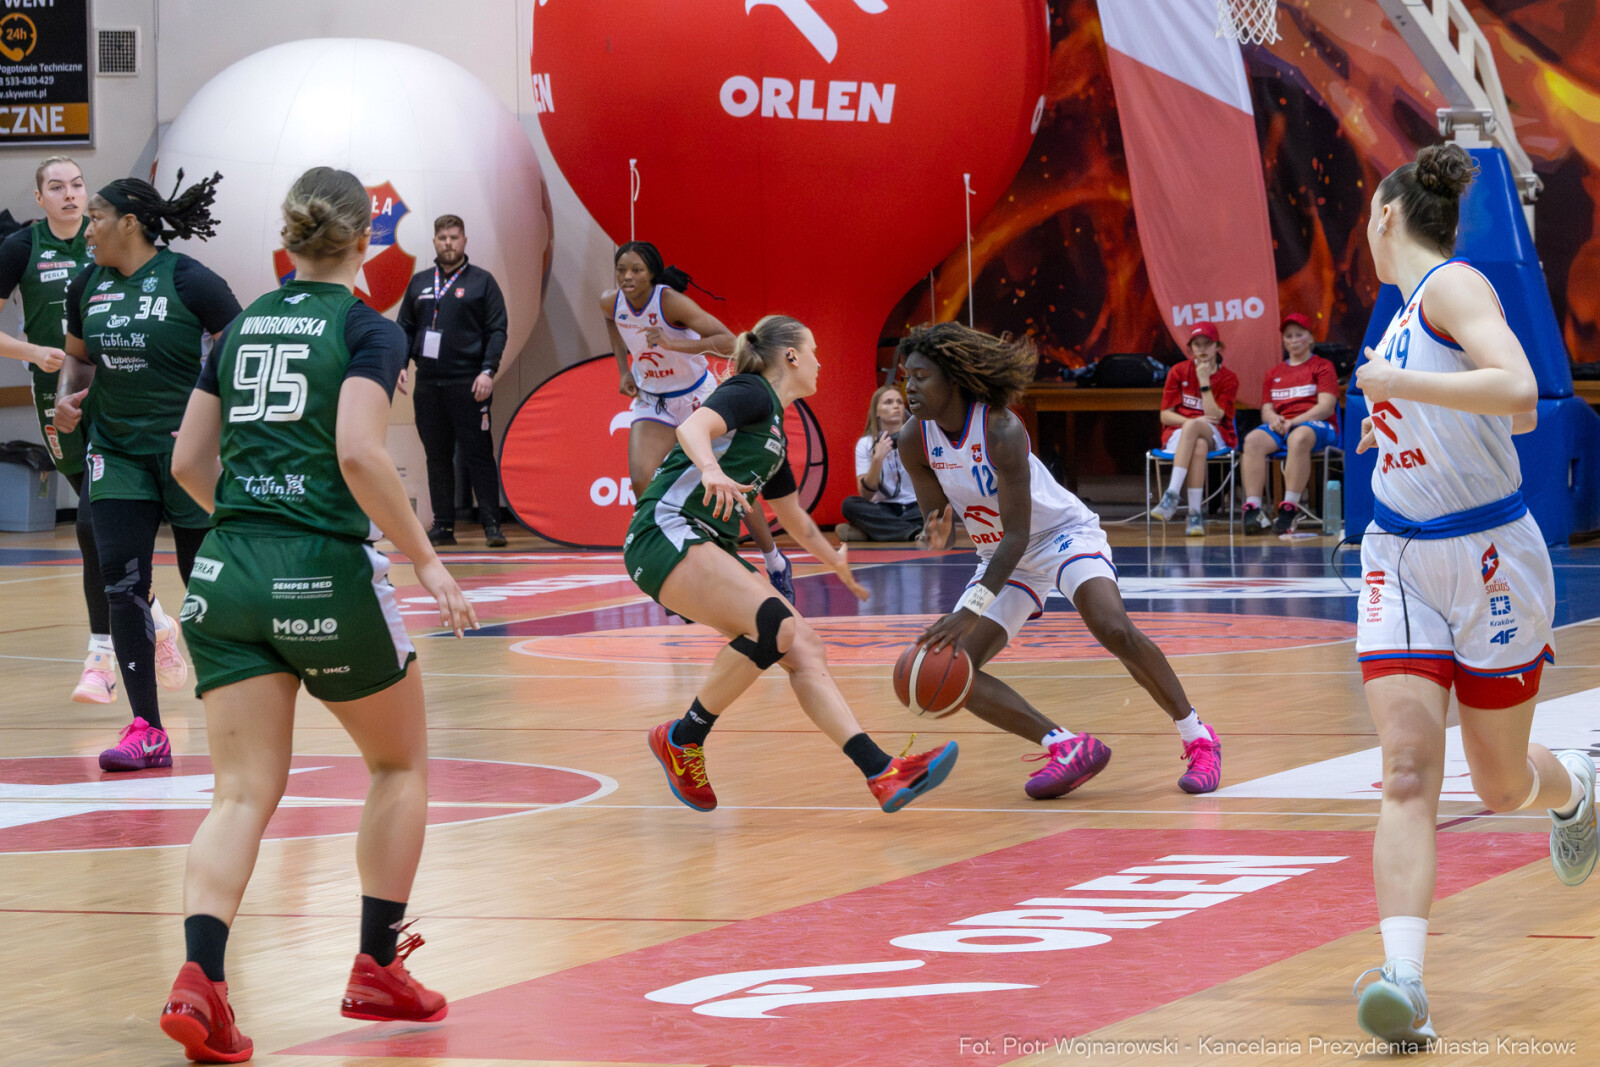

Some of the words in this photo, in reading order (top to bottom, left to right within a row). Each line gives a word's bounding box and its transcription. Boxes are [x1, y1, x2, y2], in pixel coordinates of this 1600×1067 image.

[6, 28, 27, 40] 24h
[39, 62, 82, 73] Techniczne
[5, 75, 54, 86] 533-430-429
[719, 75, 896, 124] ORLEN
[0, 106, 65, 134] CZNE
[134, 296, 168, 321] 34
[240, 316, 327, 337] WNOROWSKA
[229, 344, 310, 422] 95
[971, 465, 998, 497] 12
[273, 582, 309, 590] SEMPER
[312, 581, 332, 589] MED
[272, 617, 338, 635] MOJO
[1490, 618, 1516, 627] Kraków
[1490, 627, 1518, 645] 4F
[889, 854, 1351, 953] ORLEN
